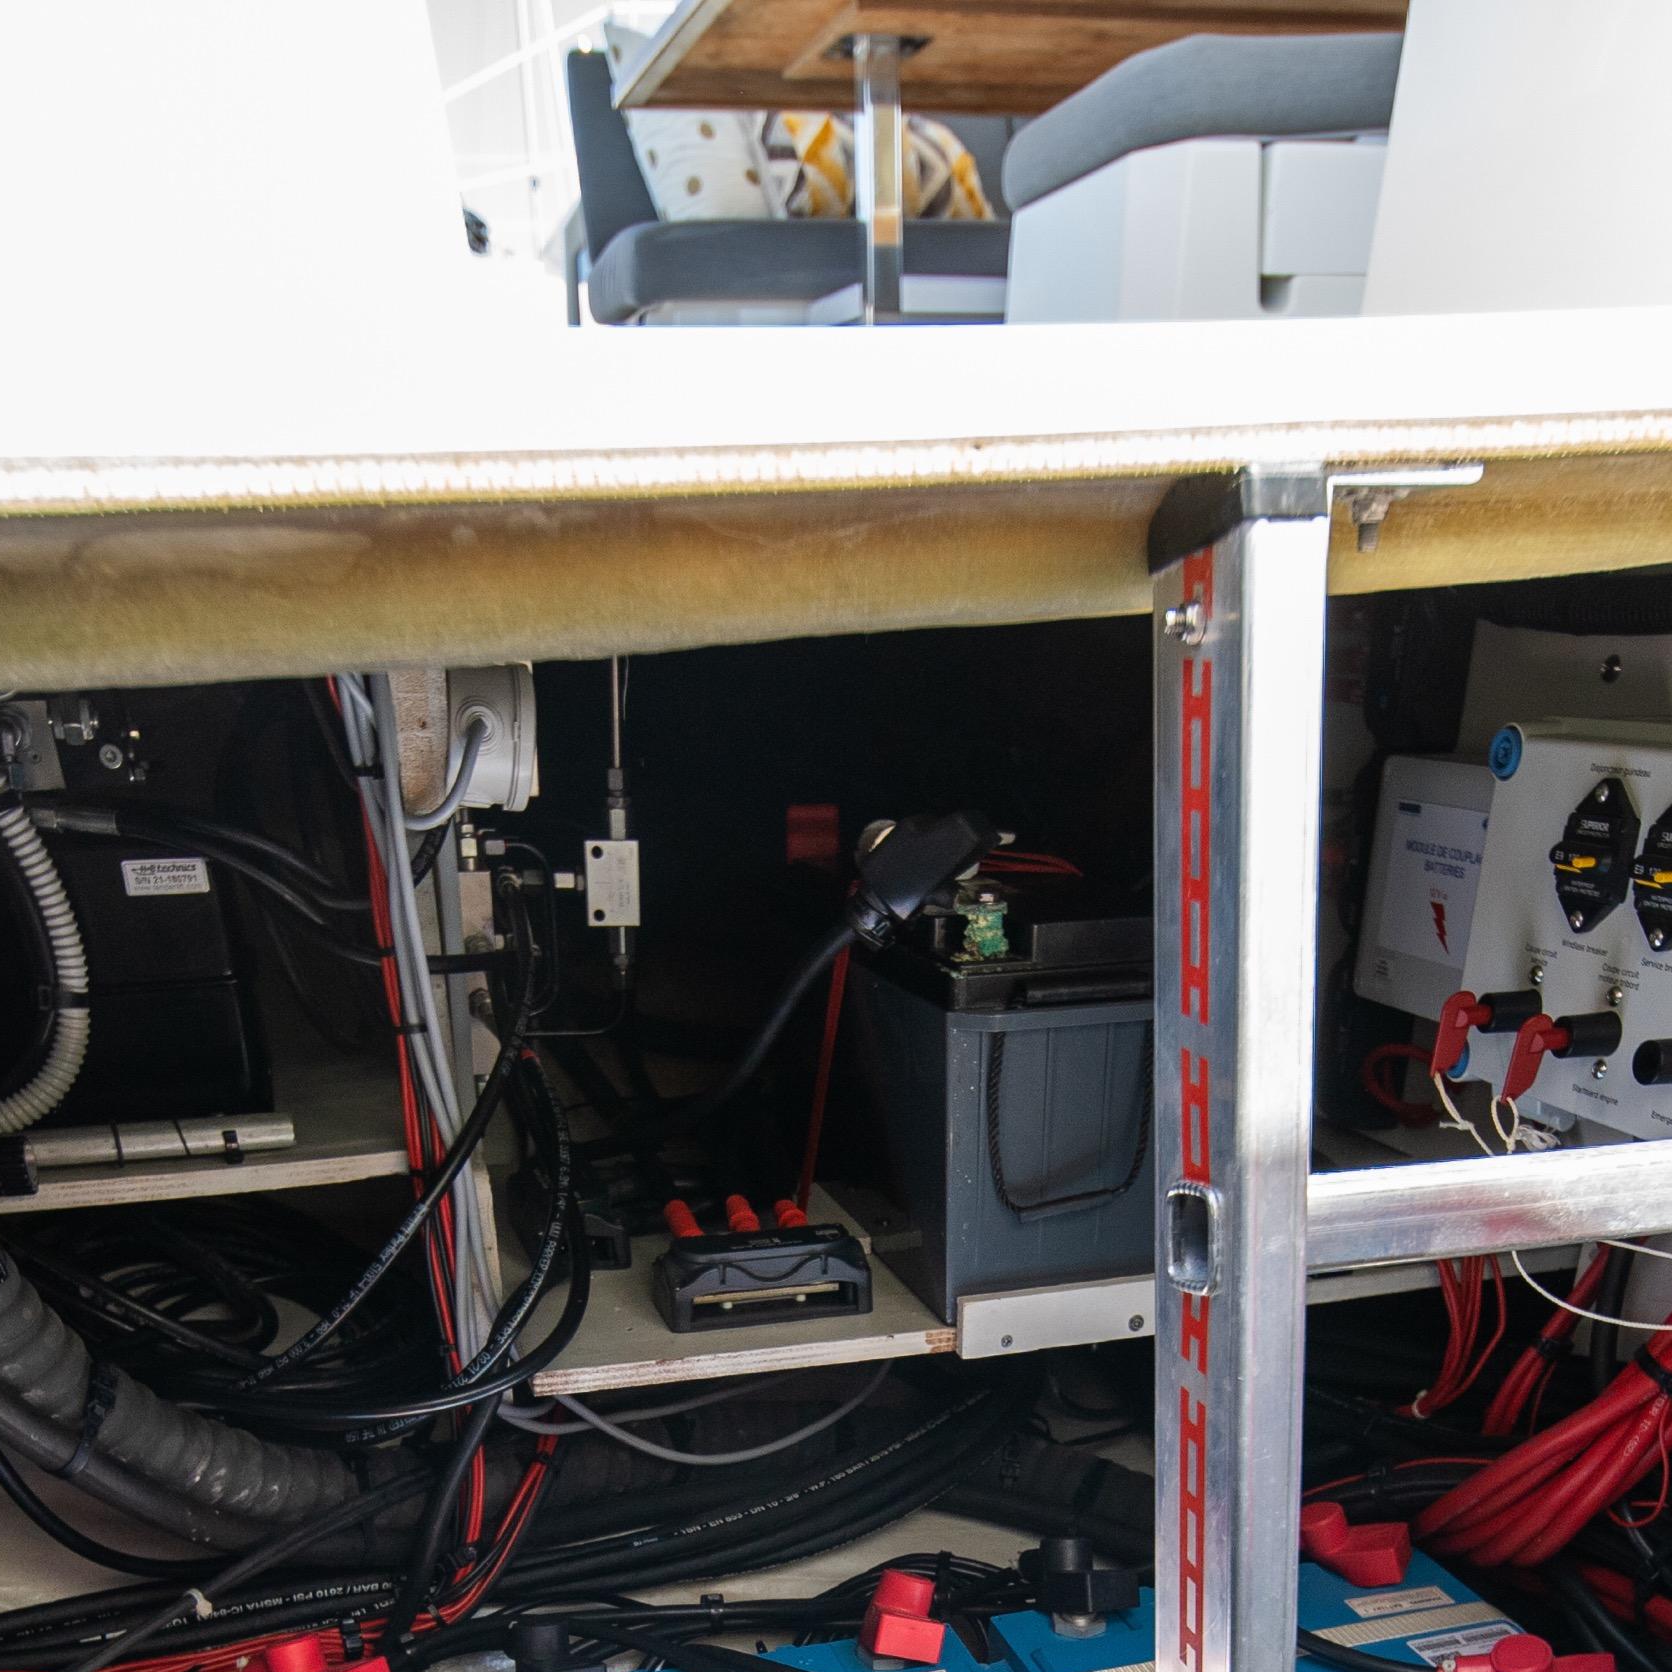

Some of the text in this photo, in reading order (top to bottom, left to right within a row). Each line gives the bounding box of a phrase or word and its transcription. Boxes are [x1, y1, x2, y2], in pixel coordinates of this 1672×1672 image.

[1580, 819, 1610, 832] SUPERIOR
[1641, 957, 1663, 973] Service
[354, 1583, 379, 1594] BAR
[293, 1591, 314, 1602] PSI
[249, 1597, 283, 1611] MSHA
